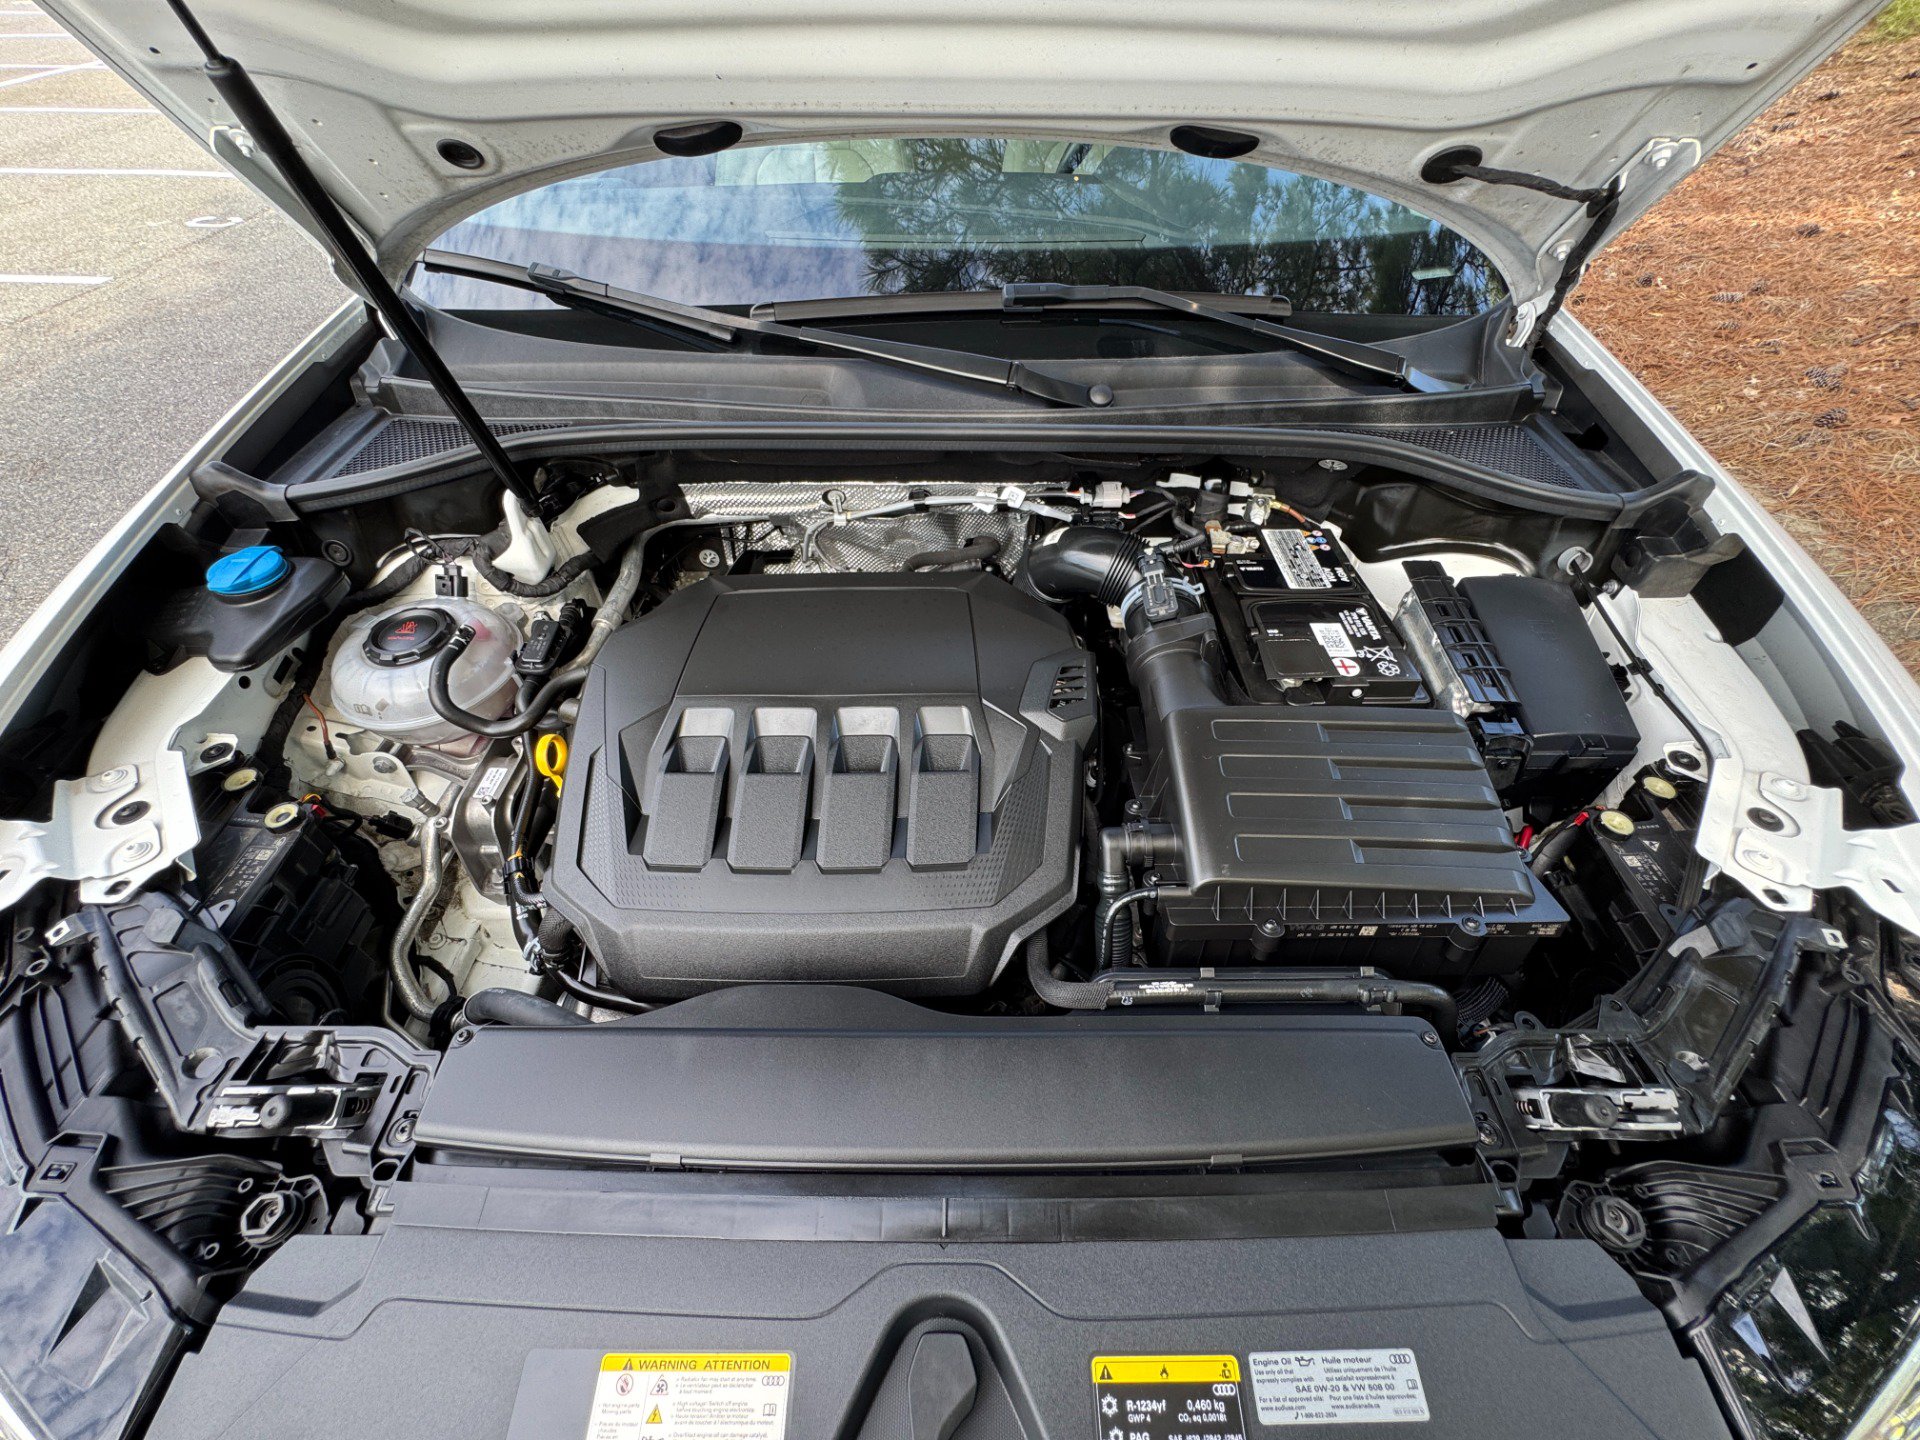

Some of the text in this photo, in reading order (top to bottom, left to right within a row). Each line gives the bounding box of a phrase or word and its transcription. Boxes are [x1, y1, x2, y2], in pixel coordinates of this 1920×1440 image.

[1362, 615, 1381, 641] VARTA
[639, 1359, 770, 1370] WARNING ATTENTION
[1252, 1357, 1292, 1368] Engine Oil
[1321, 1356, 1341, 1364] Huile
[1295, 1385, 1312, 1393] SAE
[1342, 1384, 1350, 1392] &
[1351, 1384, 1365, 1392] VW
[1385, 1383, 1395, 1391] 00
[1126, 1398, 1225, 1414] R-1234yf 0,460 kg
[1128, 1413, 1145, 1423] GWP
[1146, 1413, 1151, 1423] 4
[1192, 1414, 1202, 1424] eq
[1130, 1432, 1150, 1440] PAG
